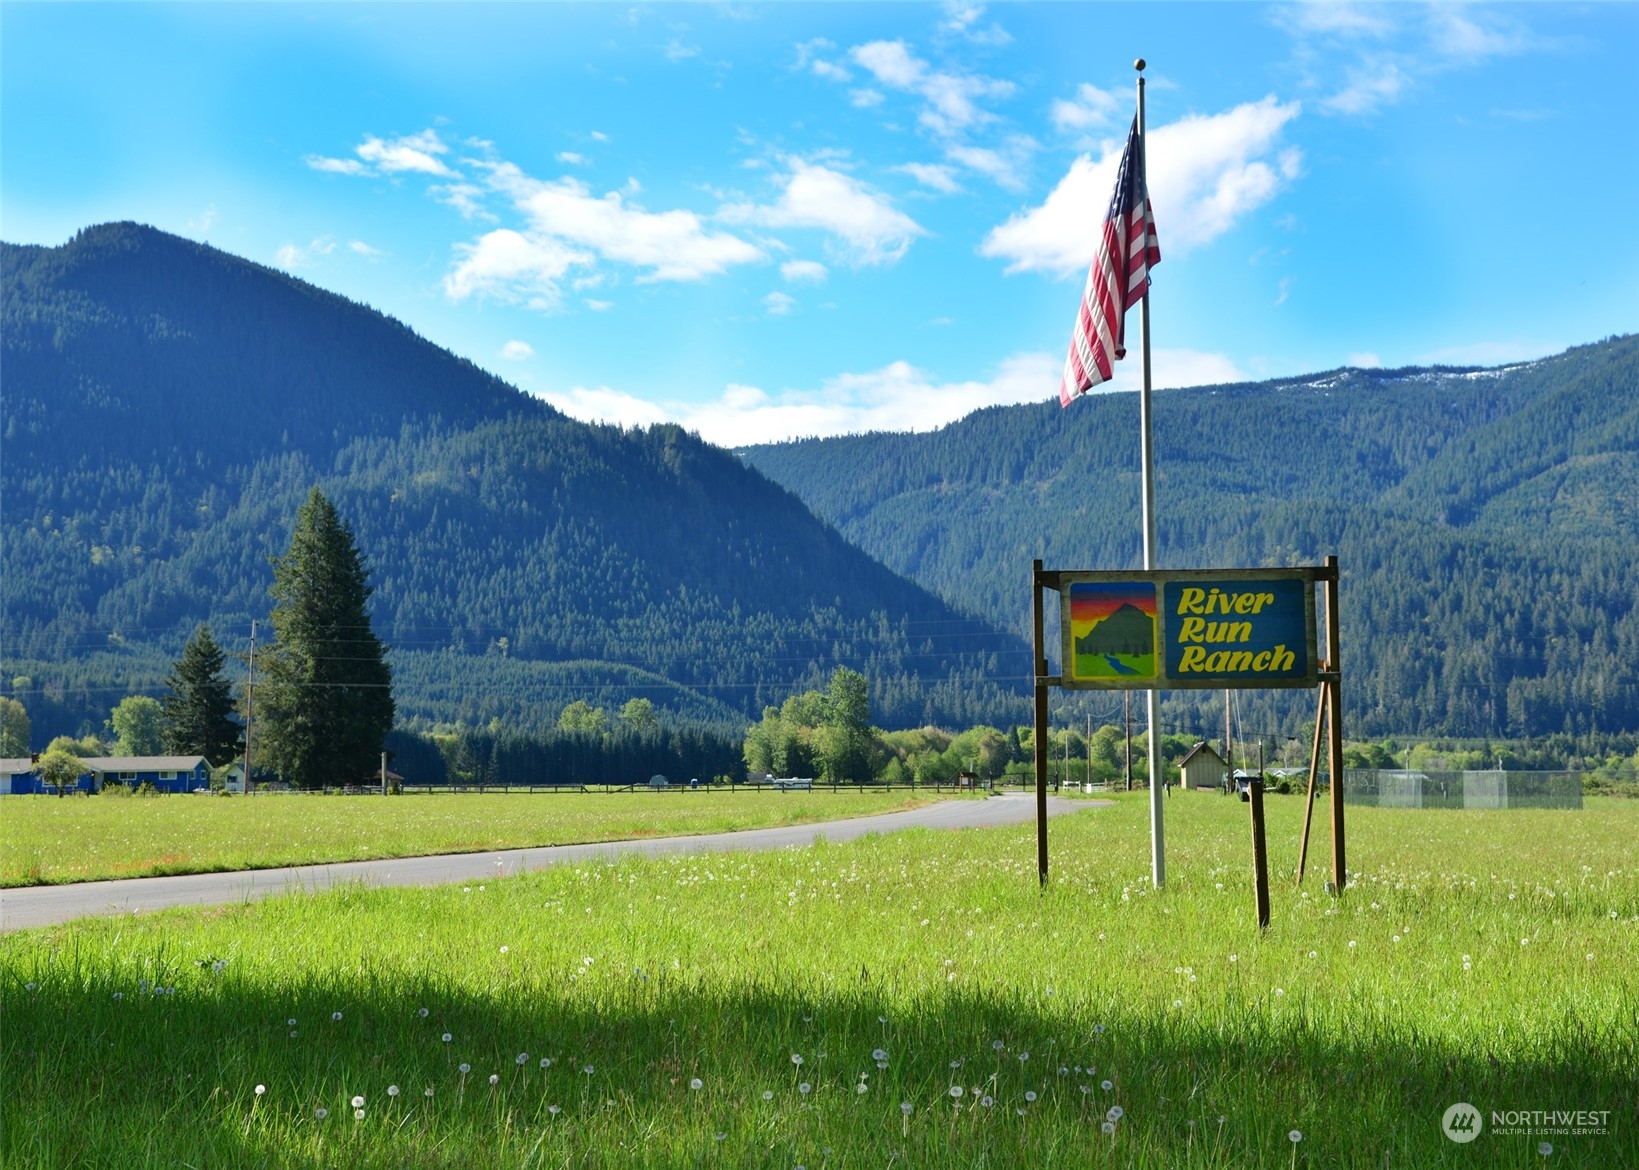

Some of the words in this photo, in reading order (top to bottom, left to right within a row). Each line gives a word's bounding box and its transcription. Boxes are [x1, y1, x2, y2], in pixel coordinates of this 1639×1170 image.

[1177, 588, 1274, 615] River
[1178, 617, 1252, 643] Run
[1178, 644, 1295, 673] Ranch
